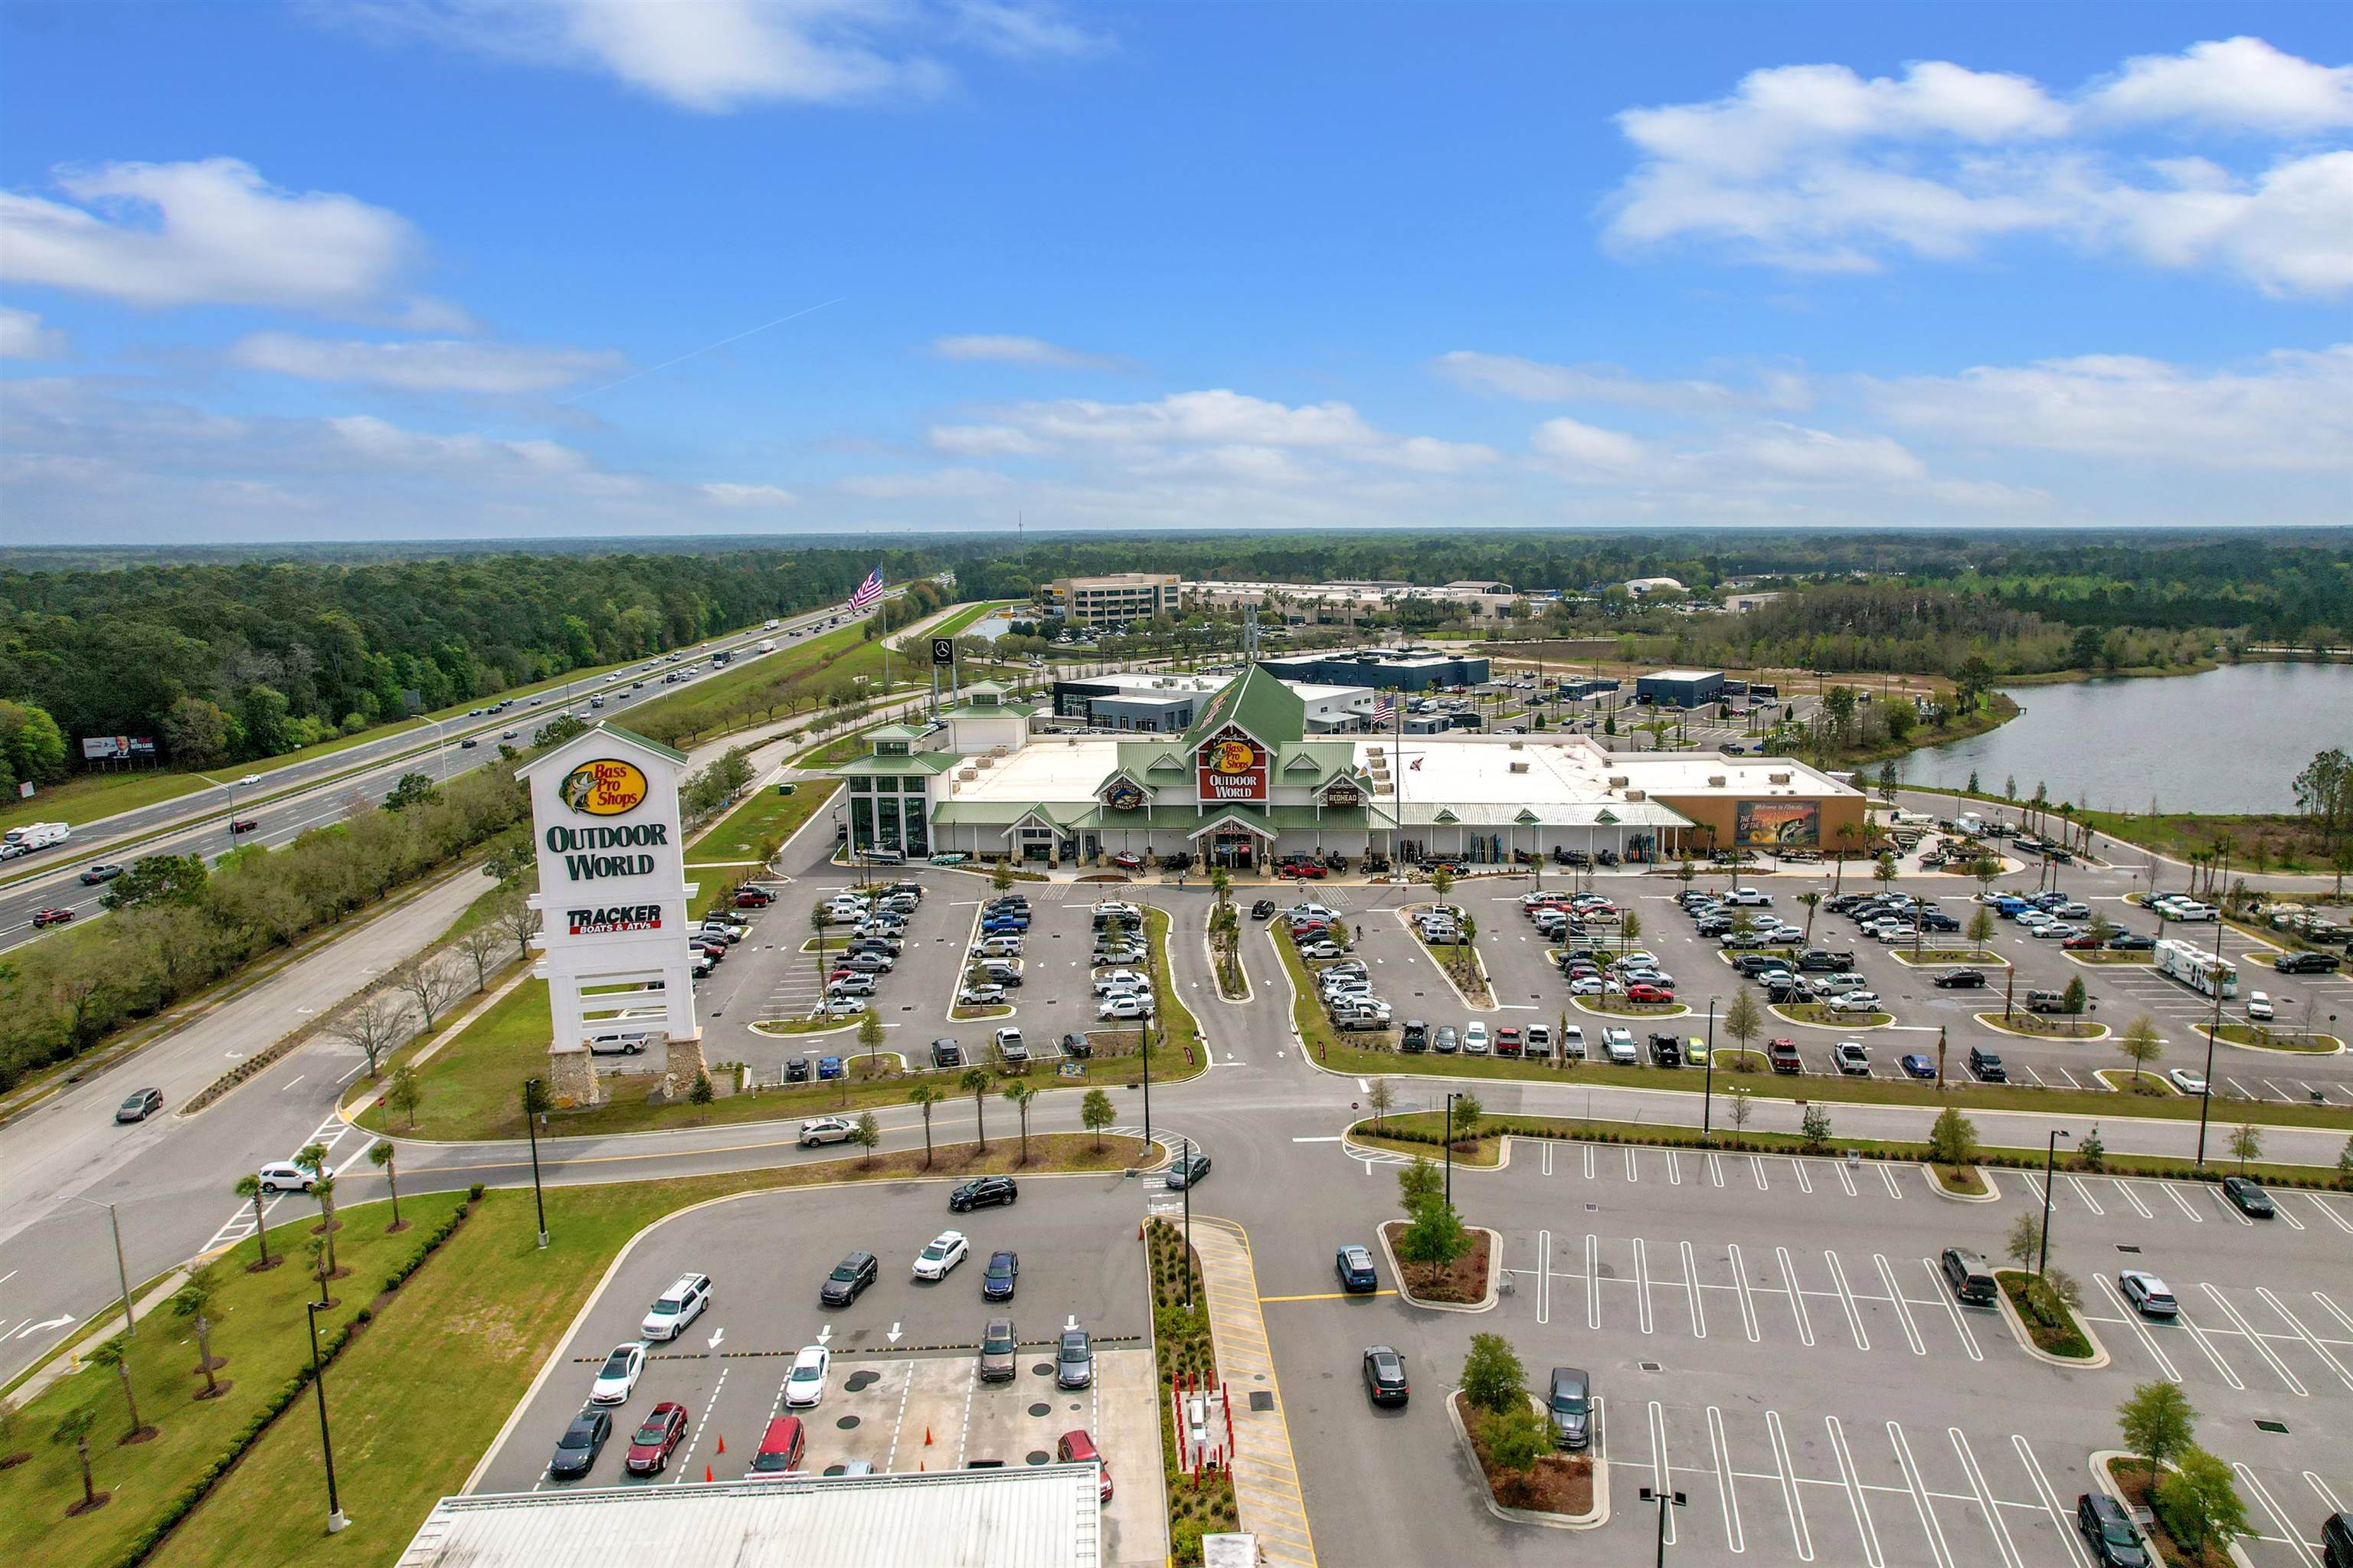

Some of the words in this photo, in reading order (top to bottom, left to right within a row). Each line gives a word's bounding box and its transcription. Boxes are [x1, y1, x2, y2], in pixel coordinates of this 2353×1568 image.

[1226, 744, 1244, 752] Bass
[1226, 752, 1240, 761] Pro
[594, 764, 627, 778] Bass
[1226, 760, 1248, 770] Shops
[597, 778, 620, 792] Pro
[1209, 774, 1257, 787] OUTDOOR
[1216, 786, 1252, 798] WORLD
[597, 792, 637, 807] Shops
[546, 823, 668, 853] OUTDOOR
[565, 853, 655, 881] WORLD
[567, 905, 661, 927] TRACKER
[580, 924, 613, 934] BOATS
[616, 923, 623, 931] &
